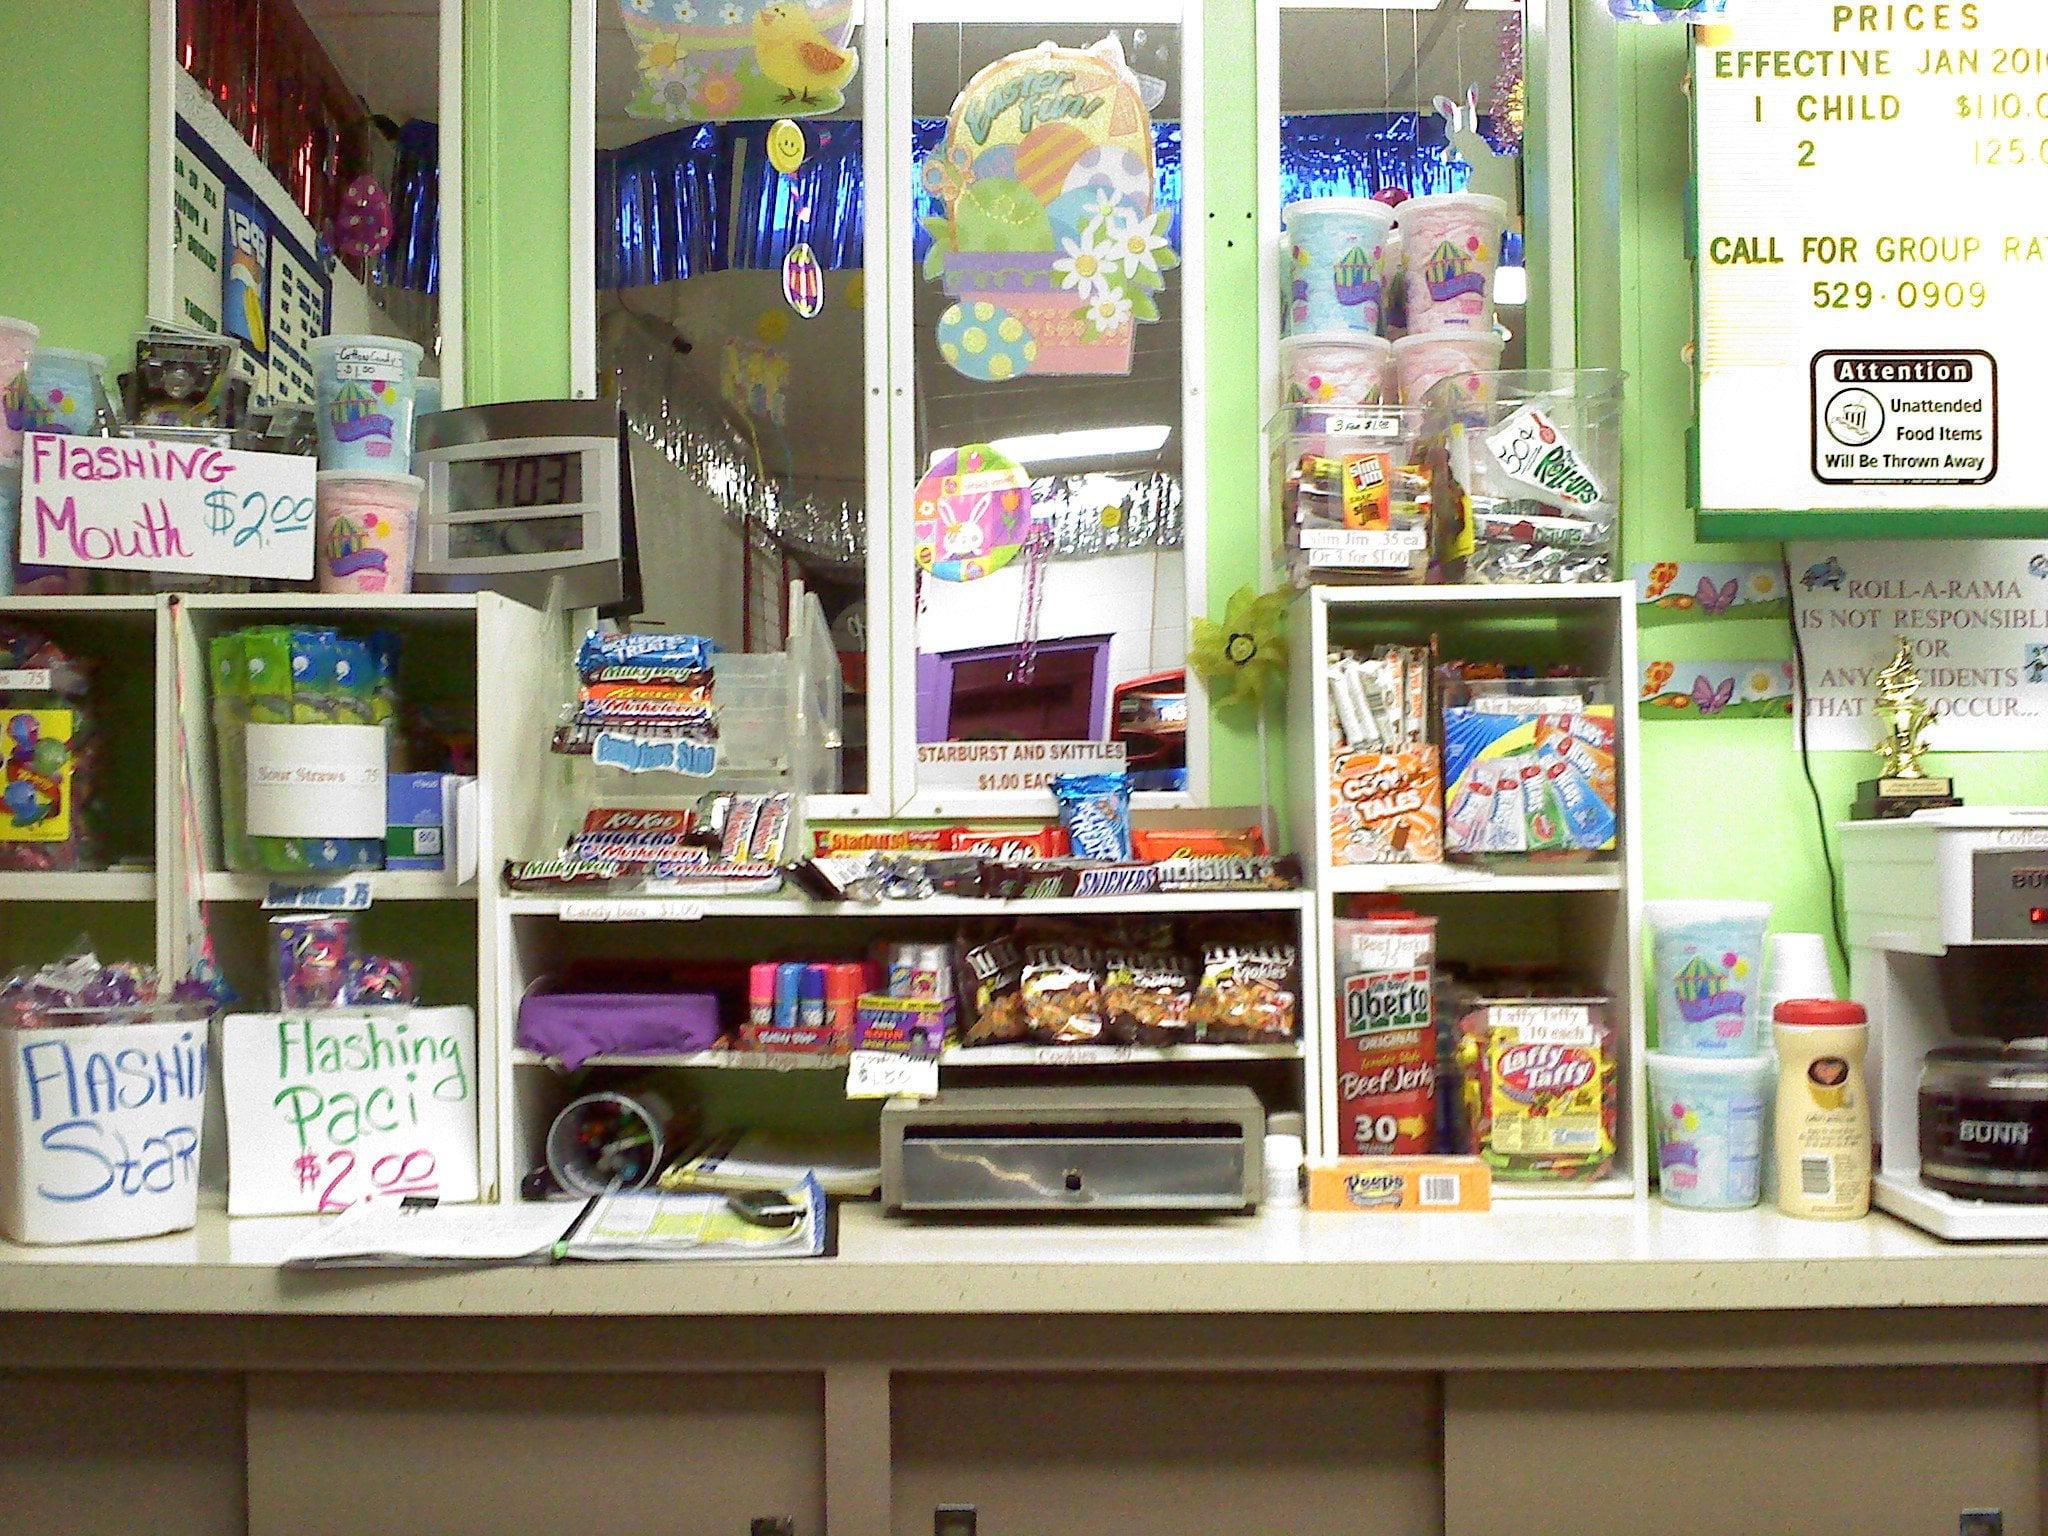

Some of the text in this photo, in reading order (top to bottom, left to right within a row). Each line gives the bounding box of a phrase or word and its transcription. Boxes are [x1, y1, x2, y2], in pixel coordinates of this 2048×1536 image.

[1833, 3, 1979, 32] PRICES
[1714, 46, 2048, 79] EFFECTIVE JAN 201
[1796, 93, 1901, 122] CHILD
[1797, 139, 1816, 167] 2
[1709, 235, 2048, 265] CALL FOR GROUP RA
[1838, 360, 1968, 382] Attention
[1890, 398, 1983, 413] Unattended
[1896, 426, 1983, 441] Food Items
[1825, 453, 1985, 471] Will Be Thrown Away
[1849, 579, 2022, 600] ROLL-A-RAMA
[1801, 608, 1823, 629] IS
[1829, 608, 1882, 629] NOT
[1910, 638, 1950, 659] OR
[1820, 667, 1875, 688] ANY
[917, 743, 1124, 762] STARBURST AND SKITTLES
[978, 772, 1063, 791] $1.00 EAC
[1079, 866, 1159, 896] SNICKERS
[1348, 982, 1428, 1022] Oberto
[277, 1012, 469, 1102] Flashing
[1502, 1045, 1564, 1077] Laffy
[1340, 1067, 1394, 1101] Beef
[1523, 1059, 1593, 1090] Taffy
[1353, 1114, 1399, 1144] 30
